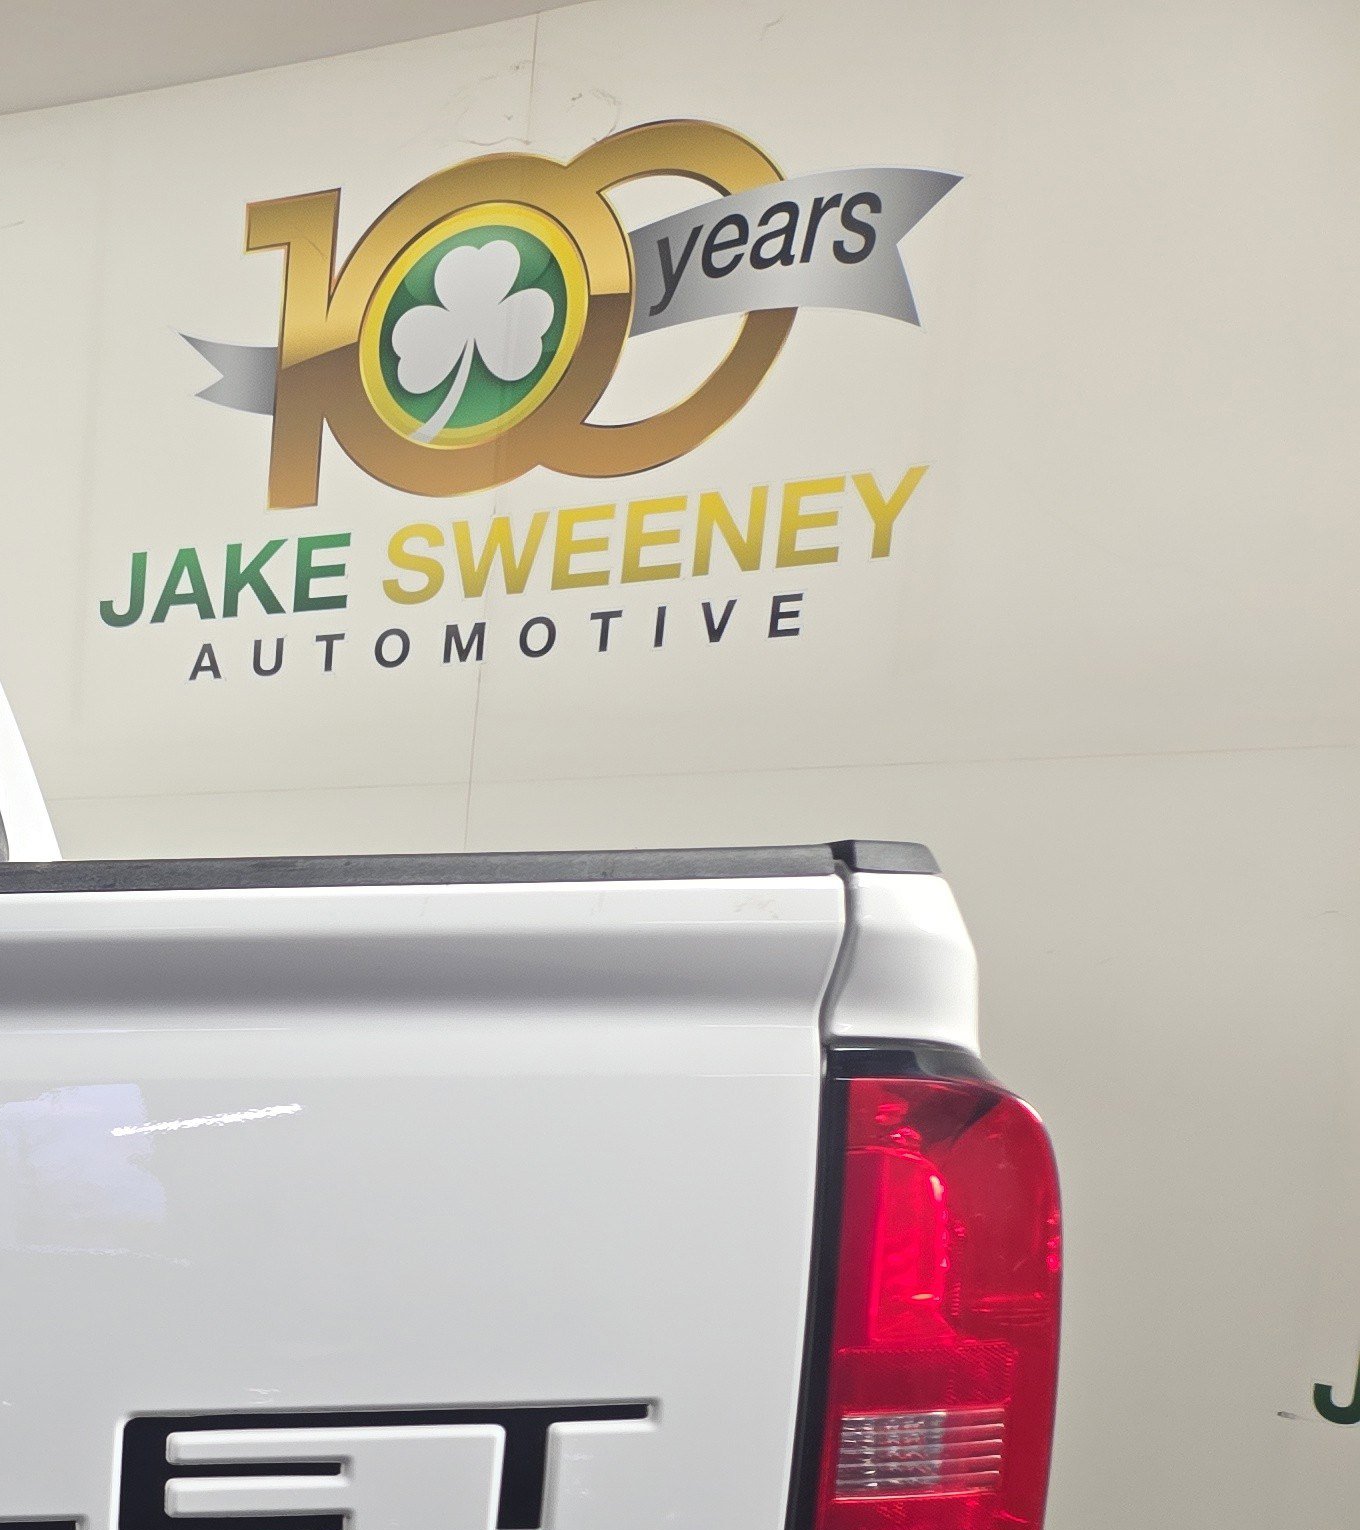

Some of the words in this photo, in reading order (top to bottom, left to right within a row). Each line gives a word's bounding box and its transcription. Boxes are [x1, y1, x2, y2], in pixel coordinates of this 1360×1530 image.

[244, 118, 800, 510] 100
[648, 190, 884, 318] years
[99, 532, 351, 628] JAKE
[382, 465, 930, 606] SWEENEY
[189, 593, 805, 681] AUTOMOTIVE
